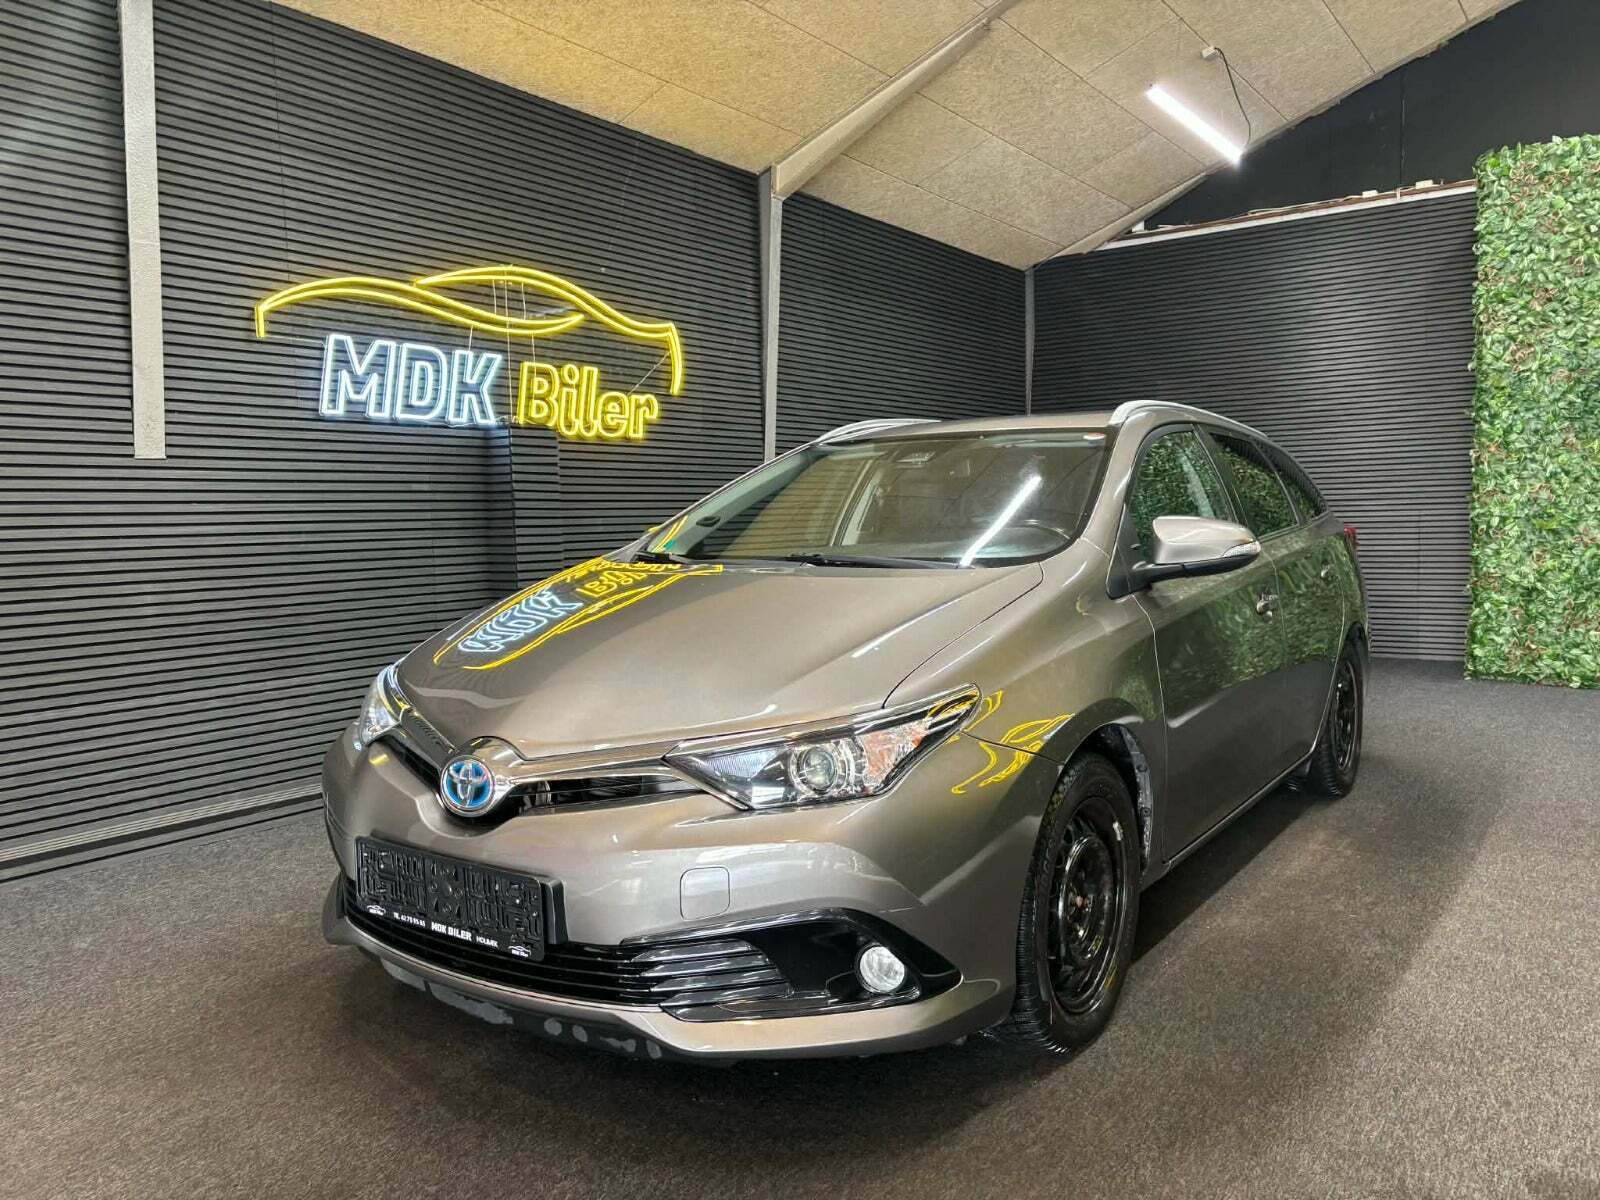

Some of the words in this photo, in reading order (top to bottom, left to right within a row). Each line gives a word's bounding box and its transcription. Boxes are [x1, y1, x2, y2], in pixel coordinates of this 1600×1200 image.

[319, 334, 503, 426] MDK
[517, 361, 660, 440] Biler
[431, 921, 447, 935] MDK
[447, 926, 472, 942] BILER
